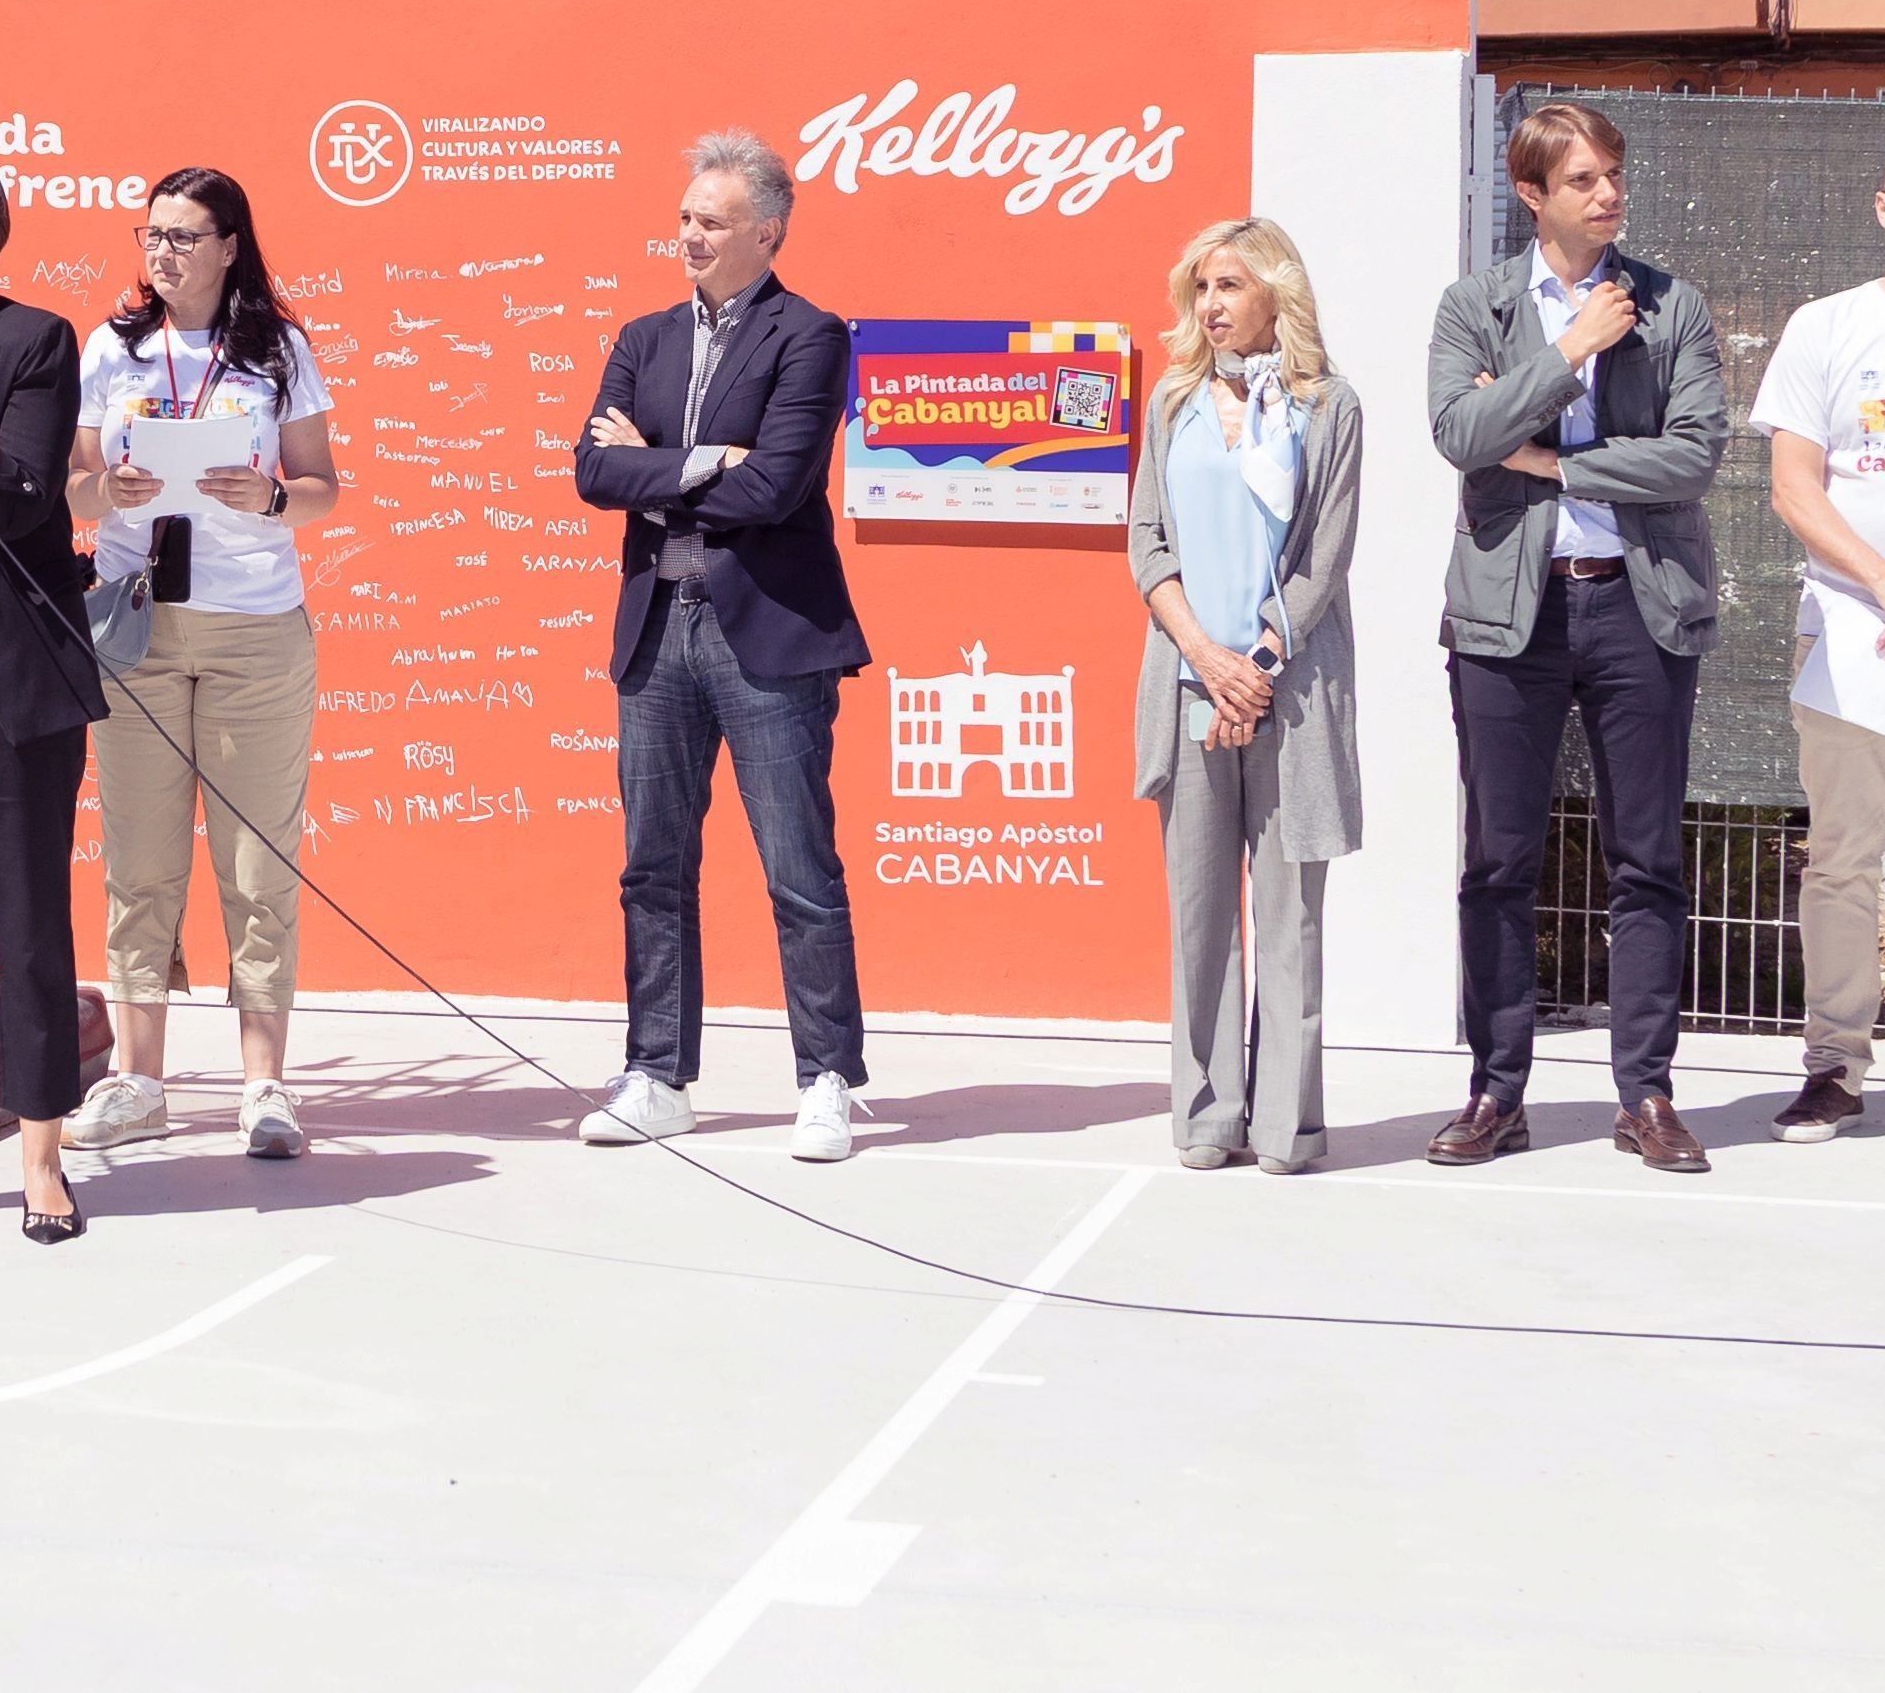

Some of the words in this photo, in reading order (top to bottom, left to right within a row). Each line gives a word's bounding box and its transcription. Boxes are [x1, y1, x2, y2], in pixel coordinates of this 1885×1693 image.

[422, 116, 545, 133] VIRALIZANDO
[422, 140, 503, 157] CULTURA
[505, 141, 518, 155] Y
[522, 139, 604, 156] VALORES
[606, 140, 622, 155] A
[794, 78, 1186, 216] Kellogg's
[421, 161, 489, 181] TRAVÉS
[494, 164, 527, 180] DEL
[531, 163, 615, 180] DEPORTE
[385, 262, 447, 283] Mireia
[584, 274, 618, 290] JUAN
[274, 268, 343, 302] Astrid
[529, 352, 575, 372] ROSA
[869, 375, 901, 395] La
[904, 373, 1006, 395] Pintada
[1007, 372, 1048, 391] del
[867, 394, 1049, 429] Cabanyal
[431, 472, 519, 493] MANUEL
[455, 550, 488, 567] JOSÉ
[314, 611, 401, 632] SAMIRA
[318, 690, 396, 713] ALFREDO
[403, 784, 531, 825] FRANCISCA
[875, 822, 994, 848] Santiago
[1000, 823, 1103, 848] Apòstol
[875, 853, 1104, 886] CABANYAL
